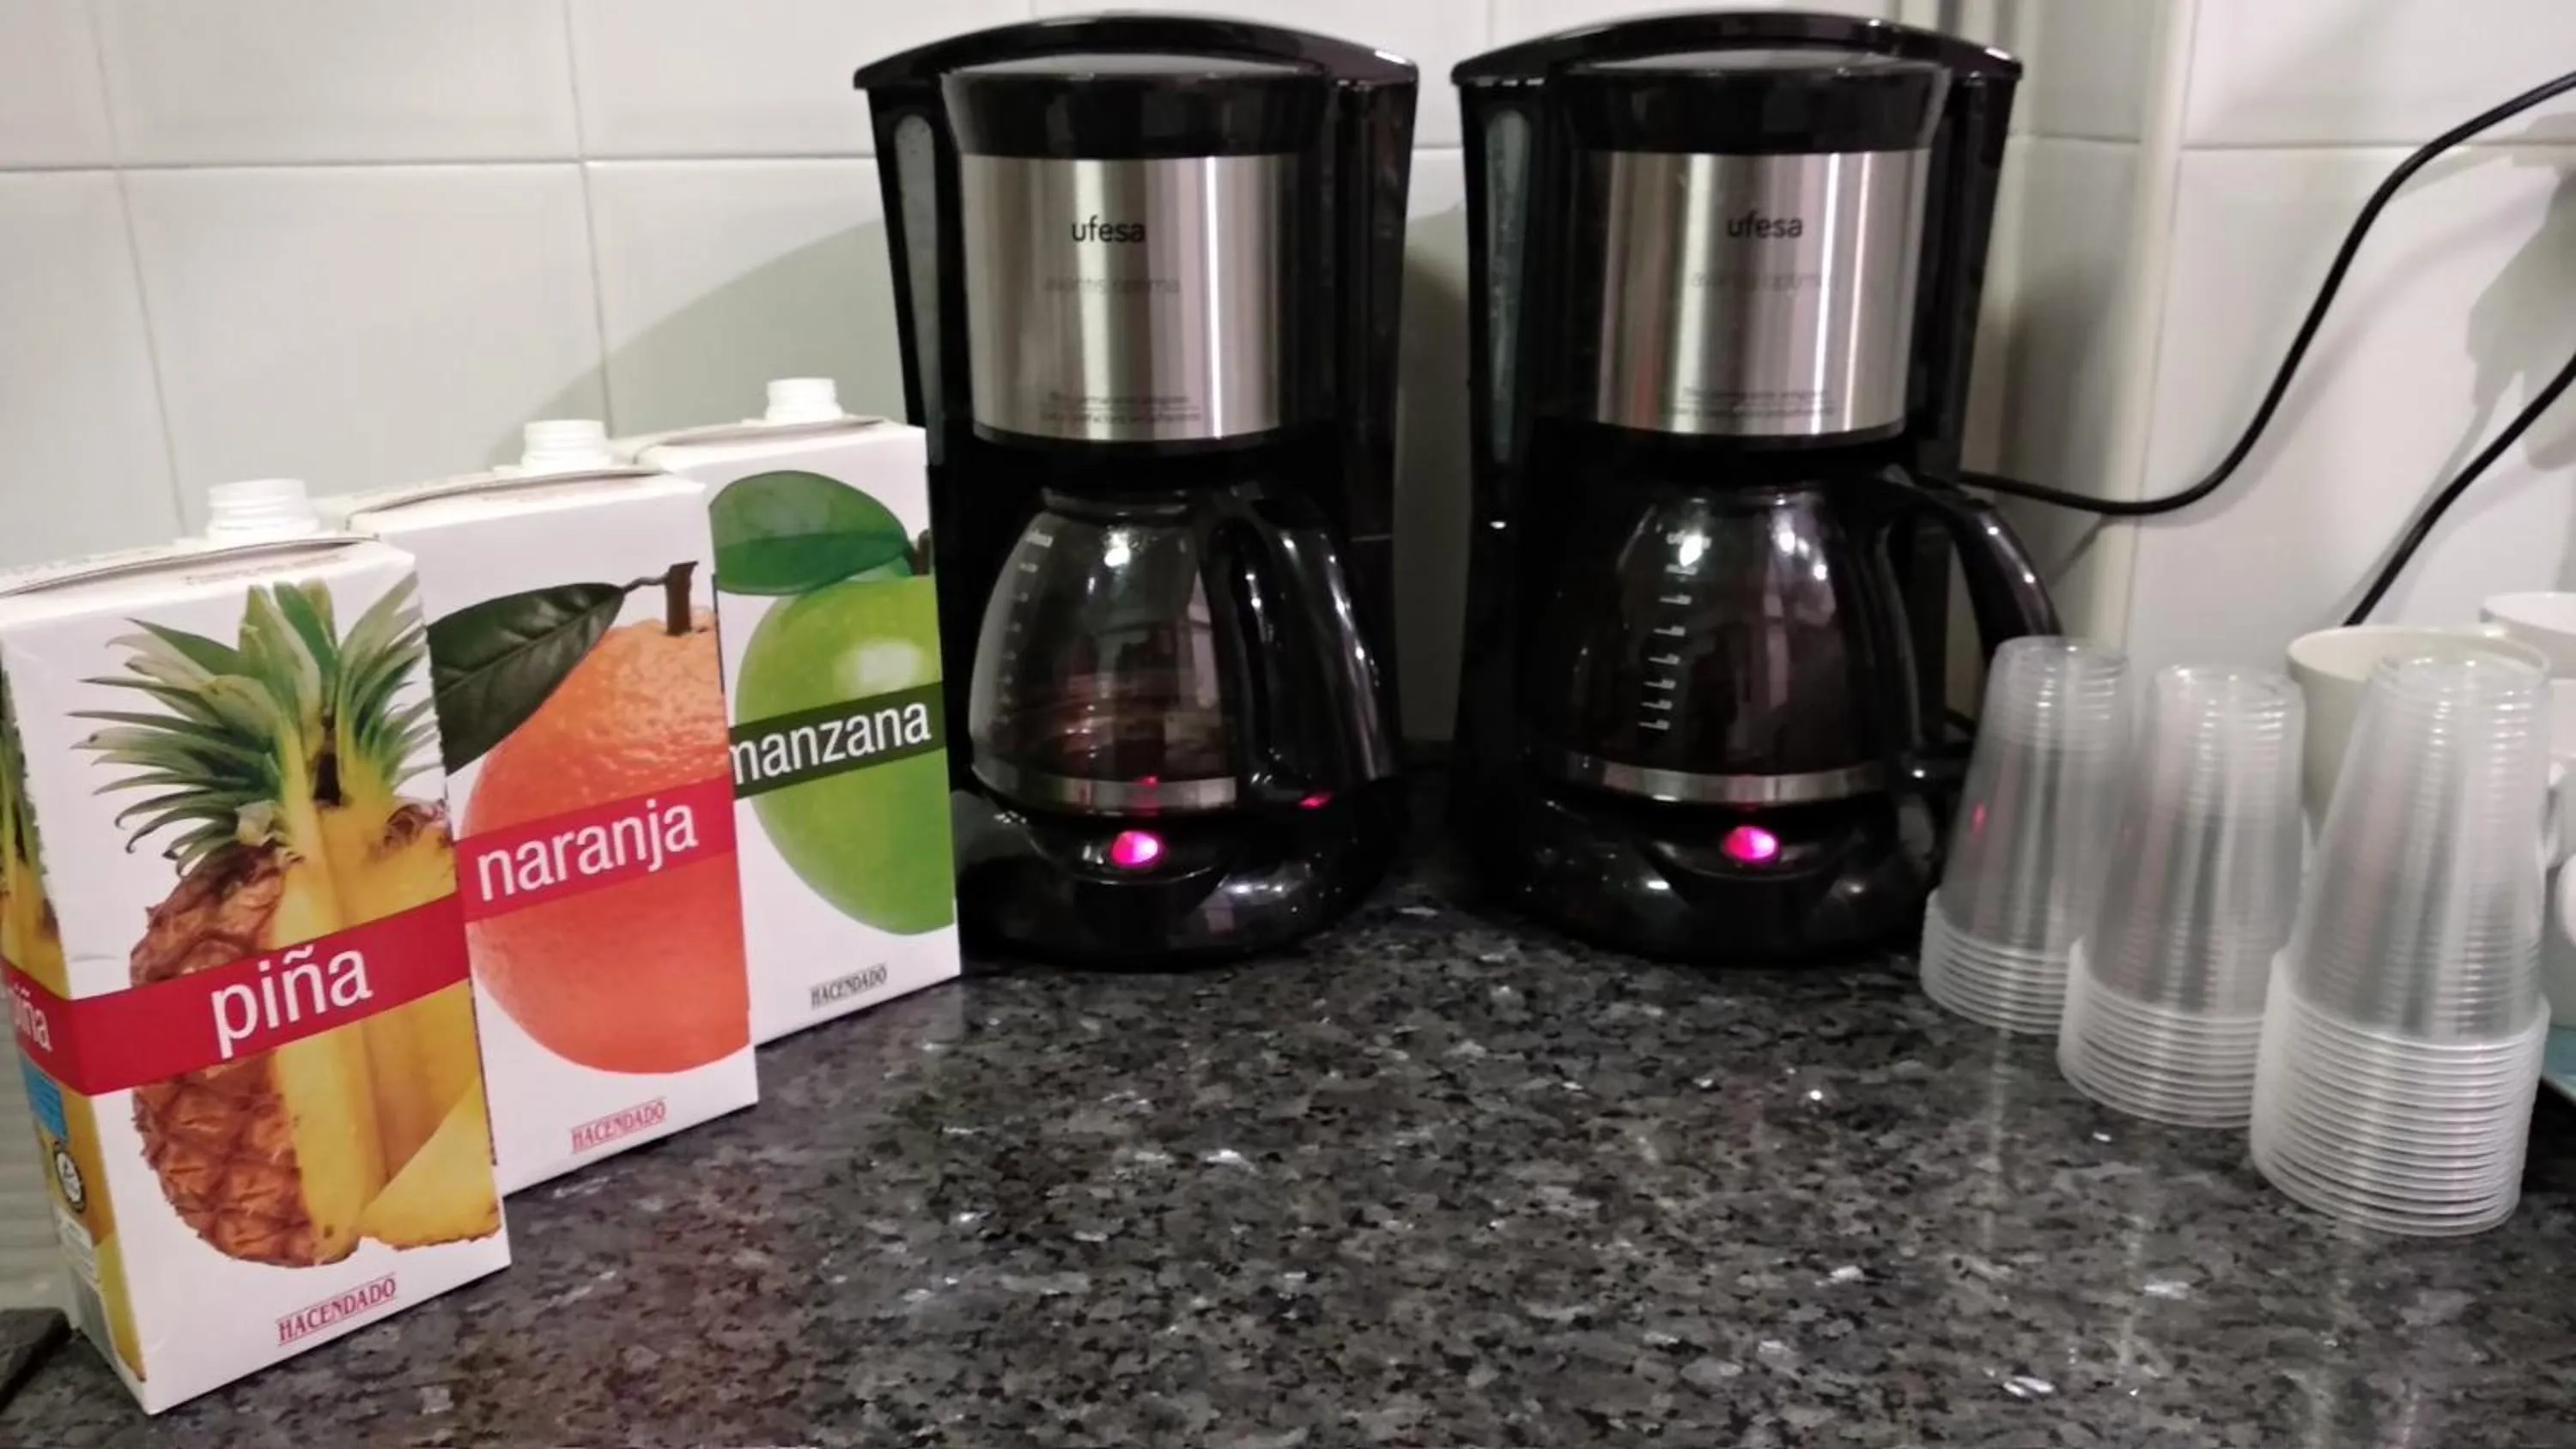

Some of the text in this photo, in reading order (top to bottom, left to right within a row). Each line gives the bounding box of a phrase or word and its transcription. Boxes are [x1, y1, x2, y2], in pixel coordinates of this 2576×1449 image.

[1072, 215, 1146, 243] ufesa
[1728, 209, 1802, 239] ufesa
[477, 798, 699, 900] naranja
[211, 945, 374, 1059] piña
[573, 1100, 666, 1153] HACENDADO
[277, 1277, 397, 1342] HACENDADO
